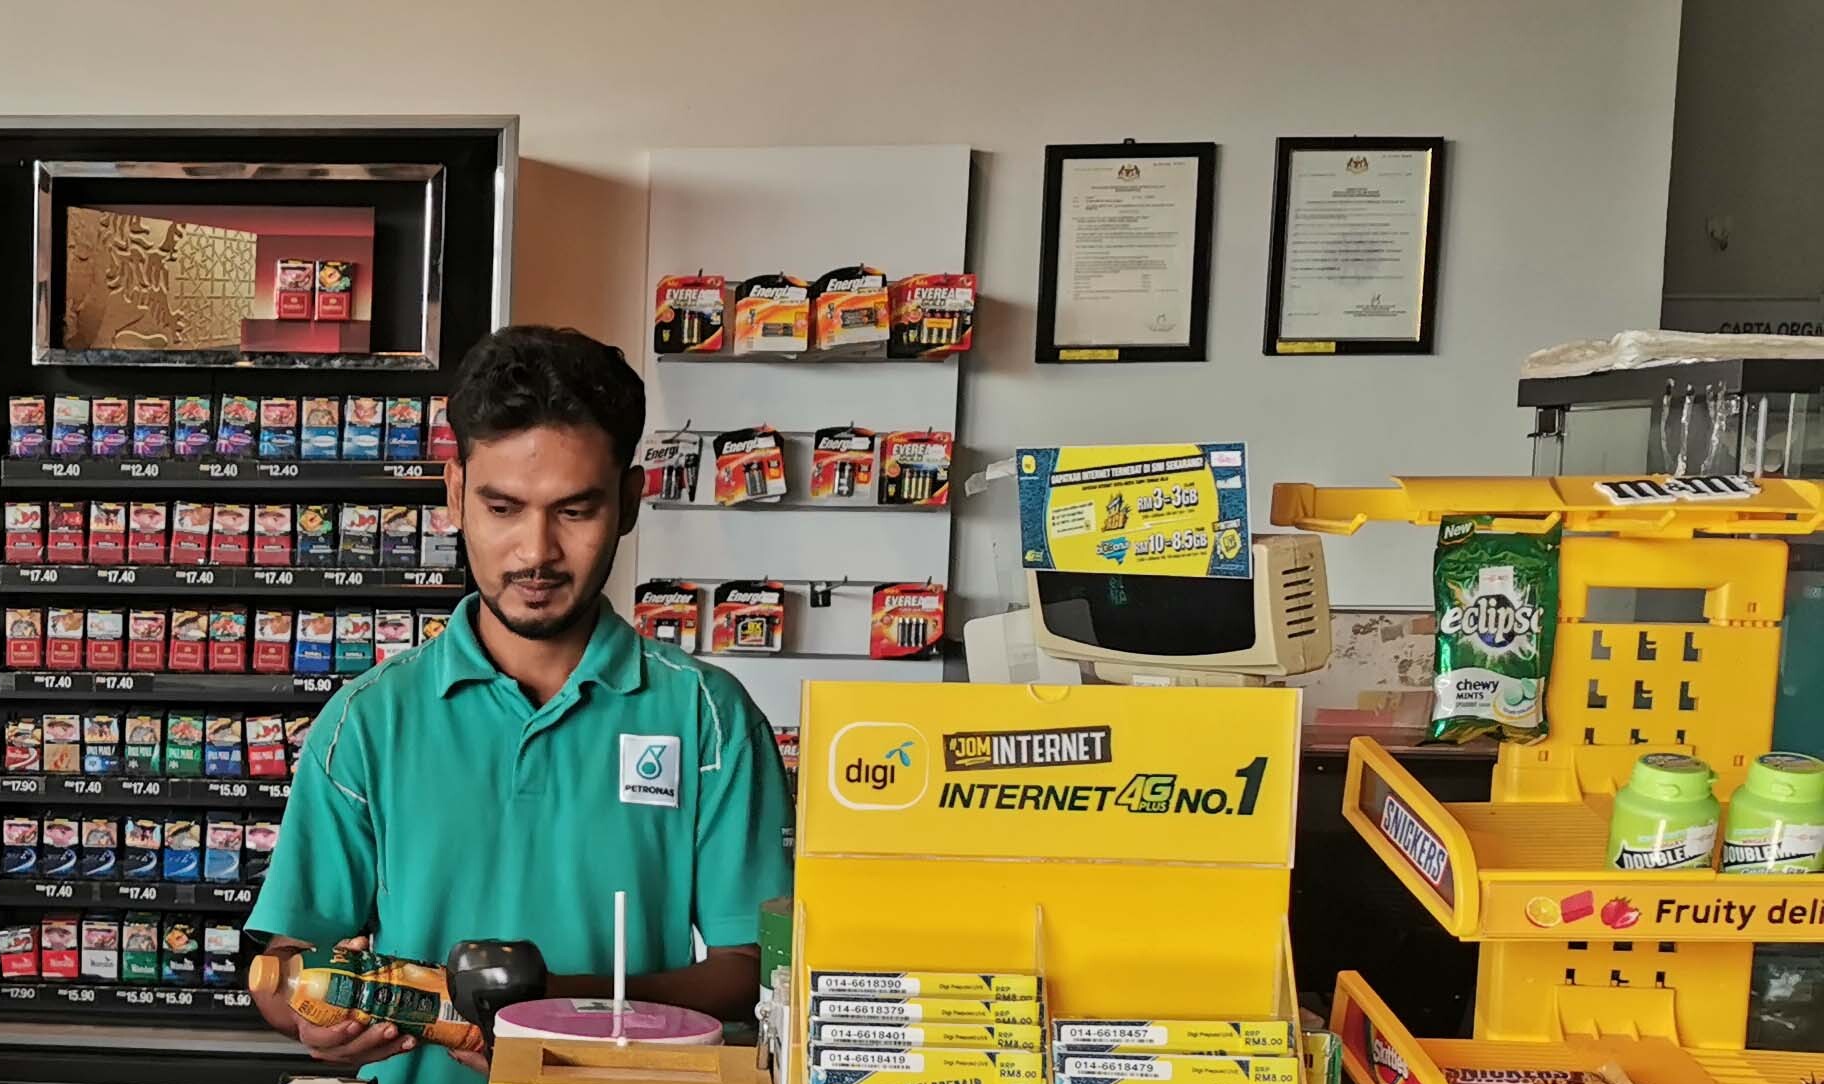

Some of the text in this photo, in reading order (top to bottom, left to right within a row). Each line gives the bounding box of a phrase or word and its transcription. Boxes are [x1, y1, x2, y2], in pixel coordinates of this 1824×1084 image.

[1444, 521, 1474, 540] New
[642, 591, 694, 604] Energizer
[1456, 679, 1499, 694] chewy
[1456, 692, 1484, 700] MINTS
[845, 757, 895, 790] digi
[625, 784, 675, 797] PETRONAS
[938, 782, 1116, 813] INTERNET
[1140, 801, 1168, 813] PLUS
[1383, 799, 1446, 883] SNICKERS
[1656, 899, 1756, 931] Fruity
[826, 978, 902, 989] 014-6618390
[829, 1004, 905, 1015] 014-6618379
[831, 1029, 906, 1040] 014-6618401
[1070, 1028, 1149, 1038] 014-6618457
[1245, 1038, 1283, 1046] RM8.00
[829, 1053, 906, 1064] 014-6618419
[1075, 1060, 1154, 1072] 014-6618479
[1000, 1070, 1037, 1079] RM8.00
[1255, 1074, 1293, 1083] RM8.00
